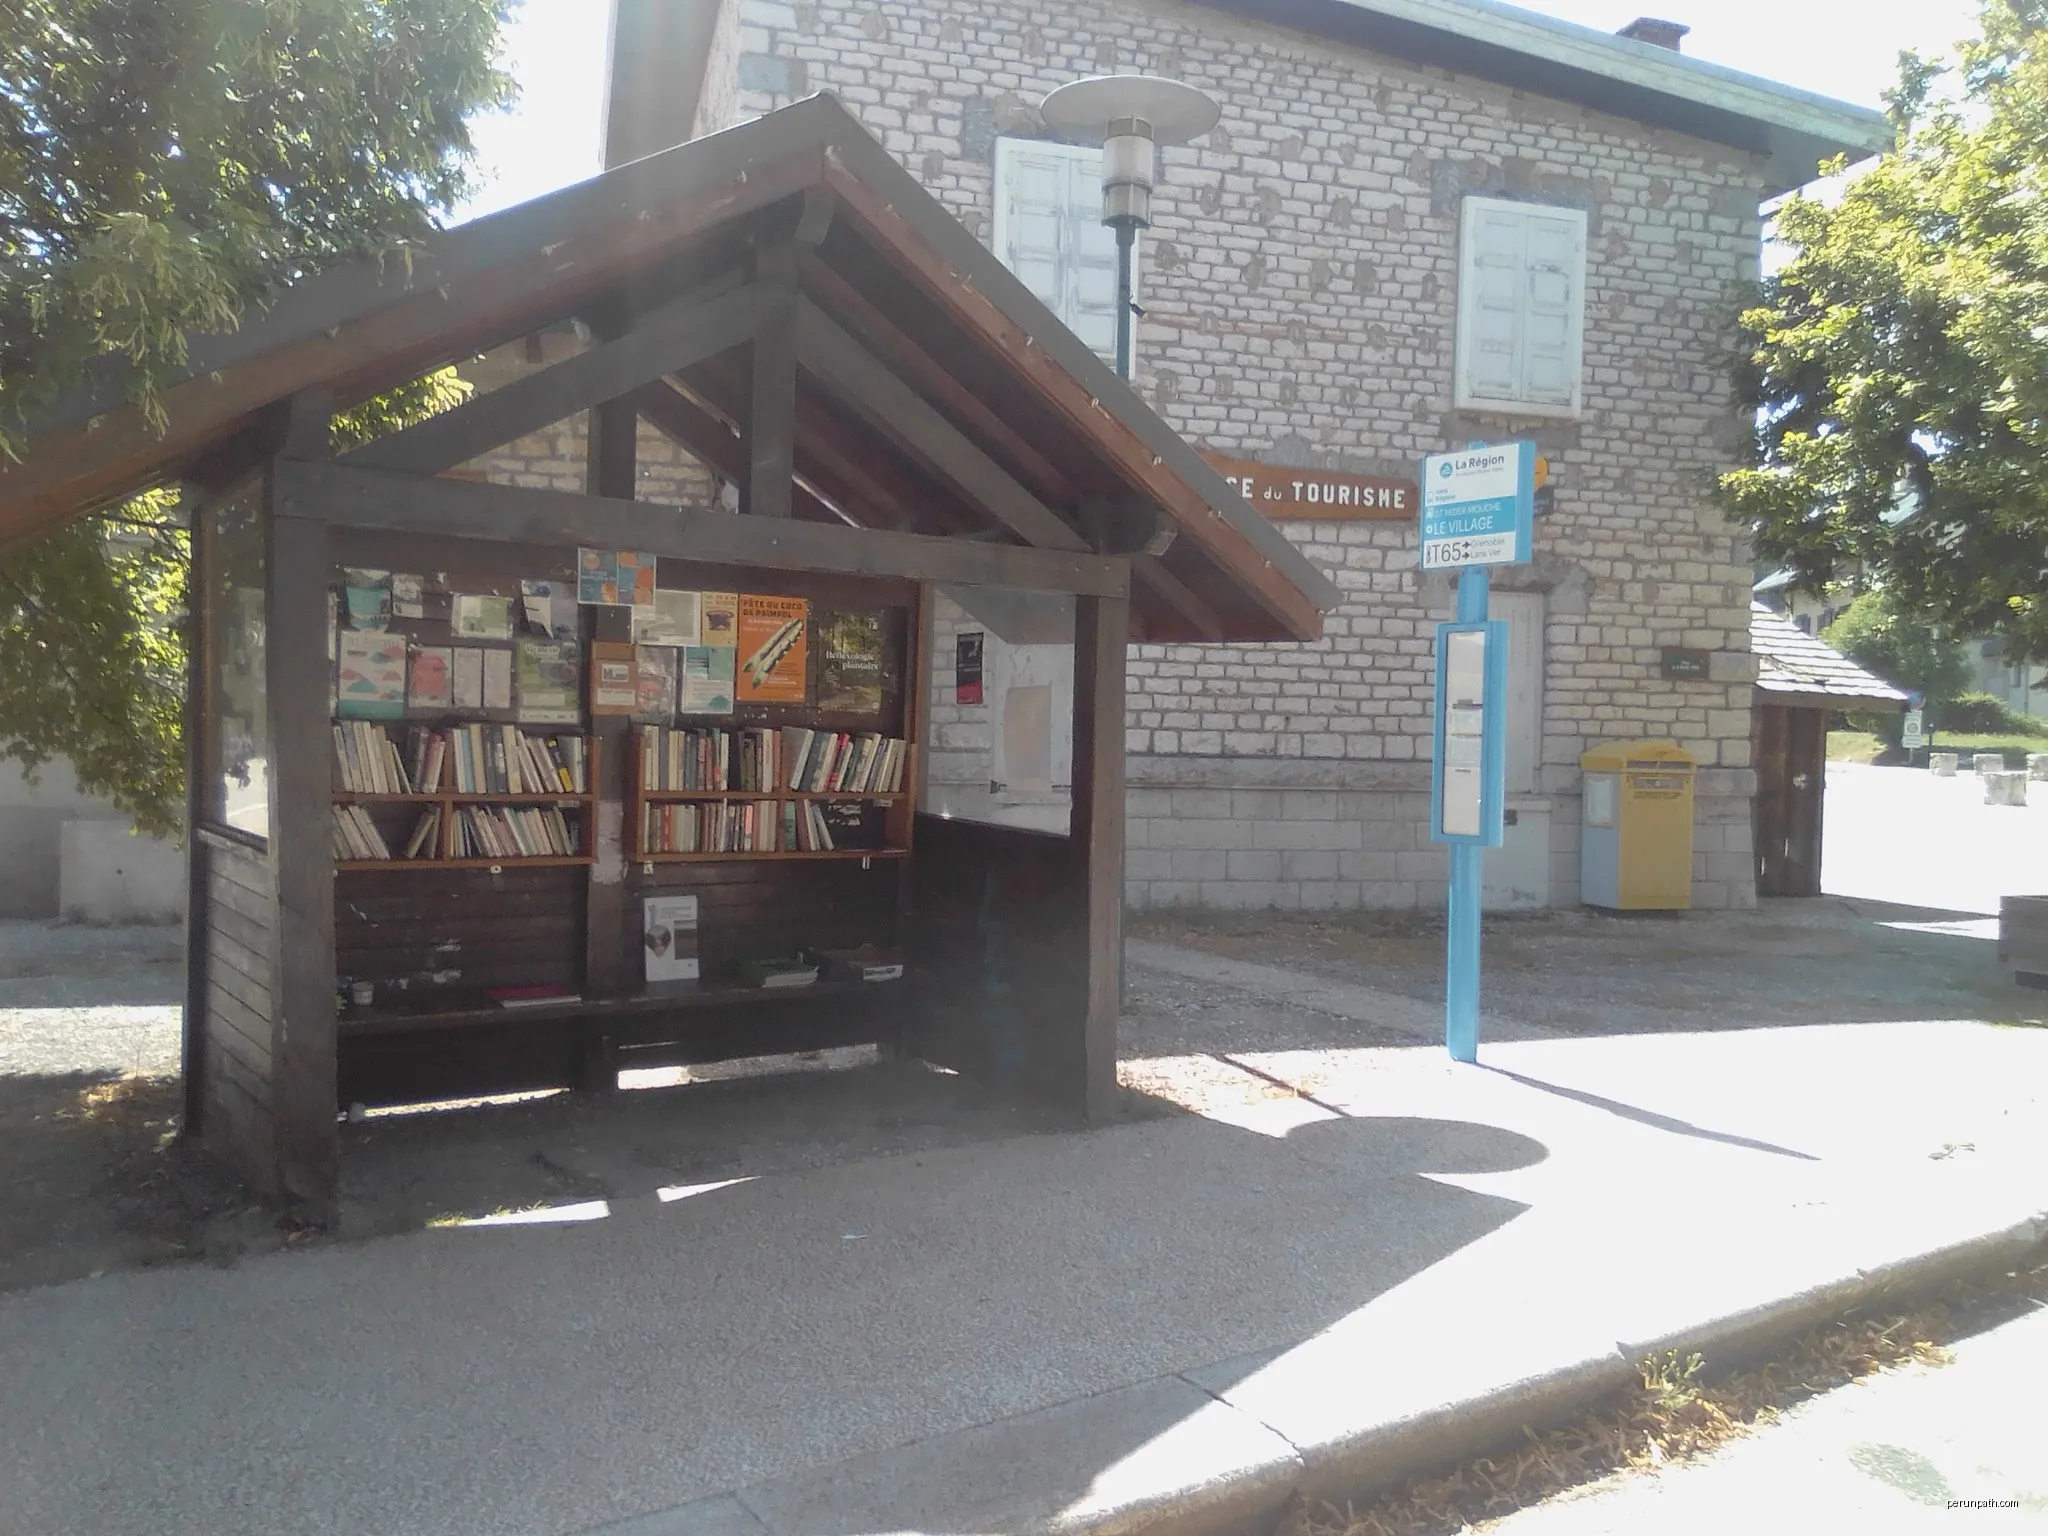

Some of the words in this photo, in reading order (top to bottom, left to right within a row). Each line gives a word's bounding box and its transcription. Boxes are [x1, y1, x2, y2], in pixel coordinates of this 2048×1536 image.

[1455, 460, 1467, 470] La
[1469, 455, 1505, 468] Région
[1263, 485, 1282, 500] du
[1292, 481, 1406, 510] TOURISME
[1434, 521, 1446, 535] LE
[1448, 516, 1494, 533] VILLAGE
[1432, 541, 1462, 562] T65
